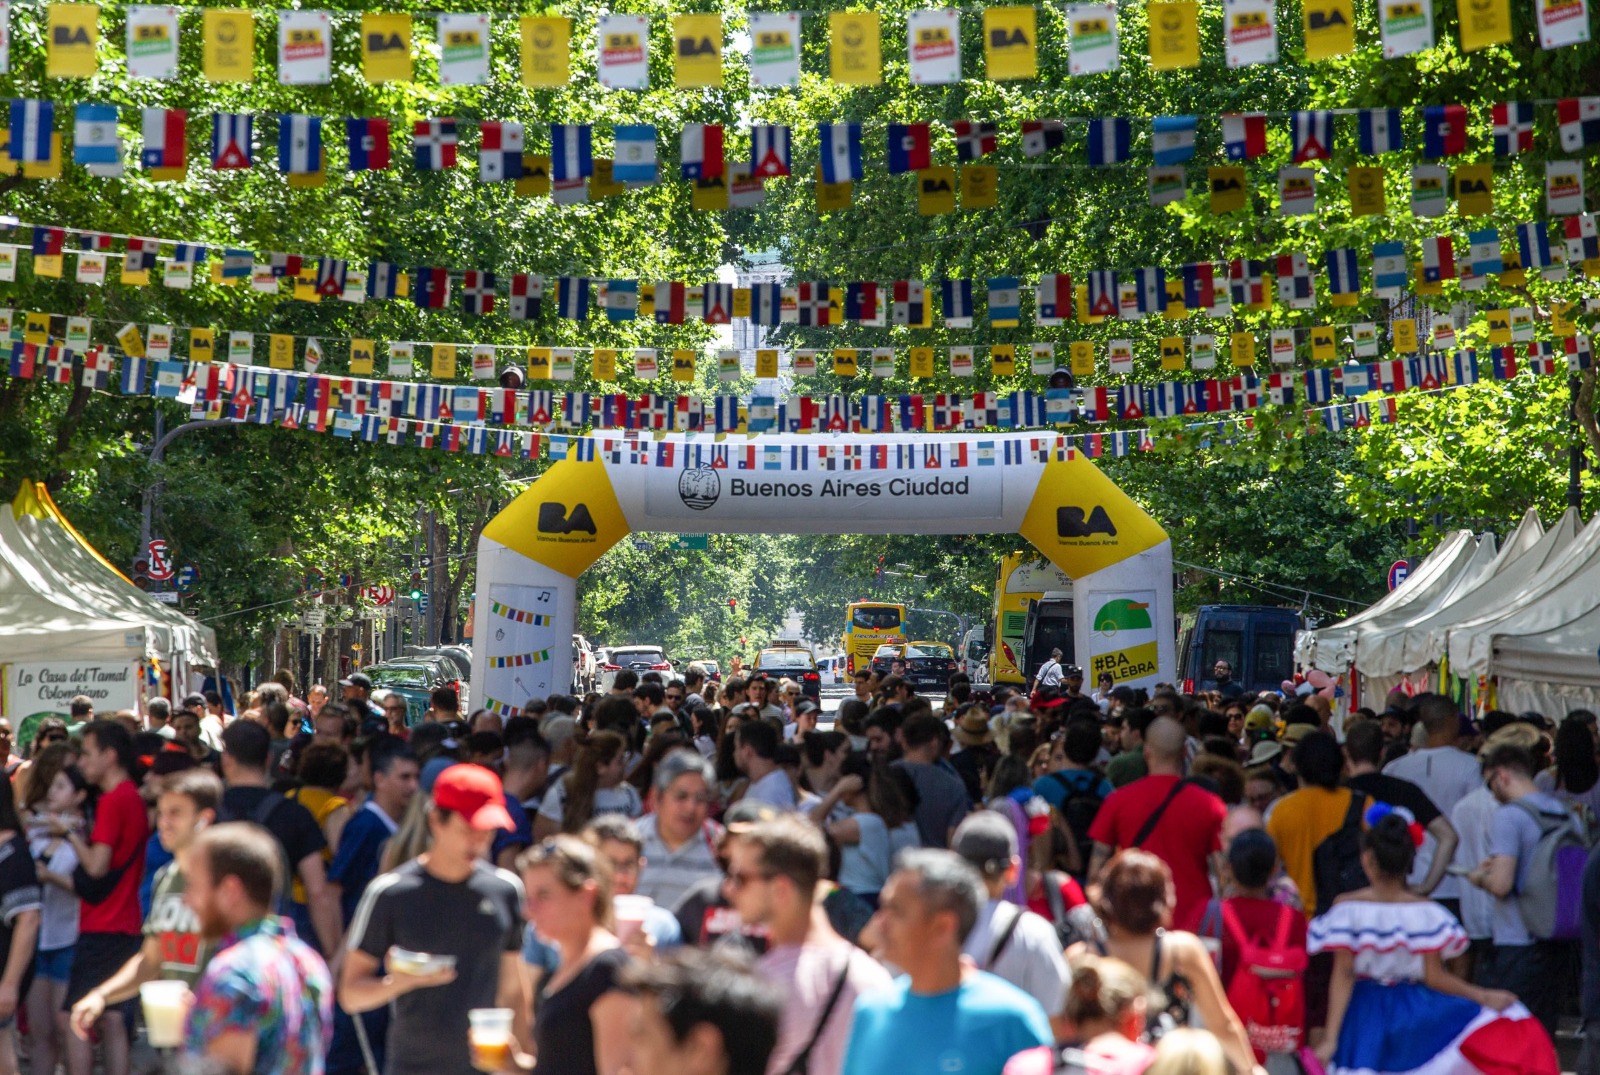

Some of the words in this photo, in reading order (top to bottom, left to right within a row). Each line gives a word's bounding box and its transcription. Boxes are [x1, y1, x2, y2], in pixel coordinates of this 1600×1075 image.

[1309, 10, 1346, 30] BA
[53, 26, 90, 45] BA
[991, 28, 1028, 48] BA
[368, 34, 405, 52] BA
[679, 38, 716, 57] BA
[923, 180, 950, 193] BA
[1213, 179, 1240, 192] BA
[1460, 180, 1488, 194] BA
[29, 323, 45, 332] BA
[1490, 320, 1508, 330] BA
[193, 339, 210, 348] BA
[1315, 337, 1332, 346] BA
[354, 350, 370, 359] BA
[1164, 348, 1181, 357] BA
[531, 357, 548, 366] BA
[675, 359, 692, 368] BA
[730, 479, 813, 498] Buenos
[820, 479, 881, 498] Aires
[888, 475, 969, 496] Ciudad
[537, 501, 597, 535] BA
[1056, 505, 1118, 537] BA
[537, 535, 557, 543] Vamos
[1094, 652, 1130, 671] #BA
[17, 669, 33, 687] La
[38, 668, 67, 684] Casa
[69, 667, 89, 684] del
[88, 667, 129, 683] Tamal
[1108, 661, 1156, 681] LEBRA
[38, 685, 109, 700] Colombiano
